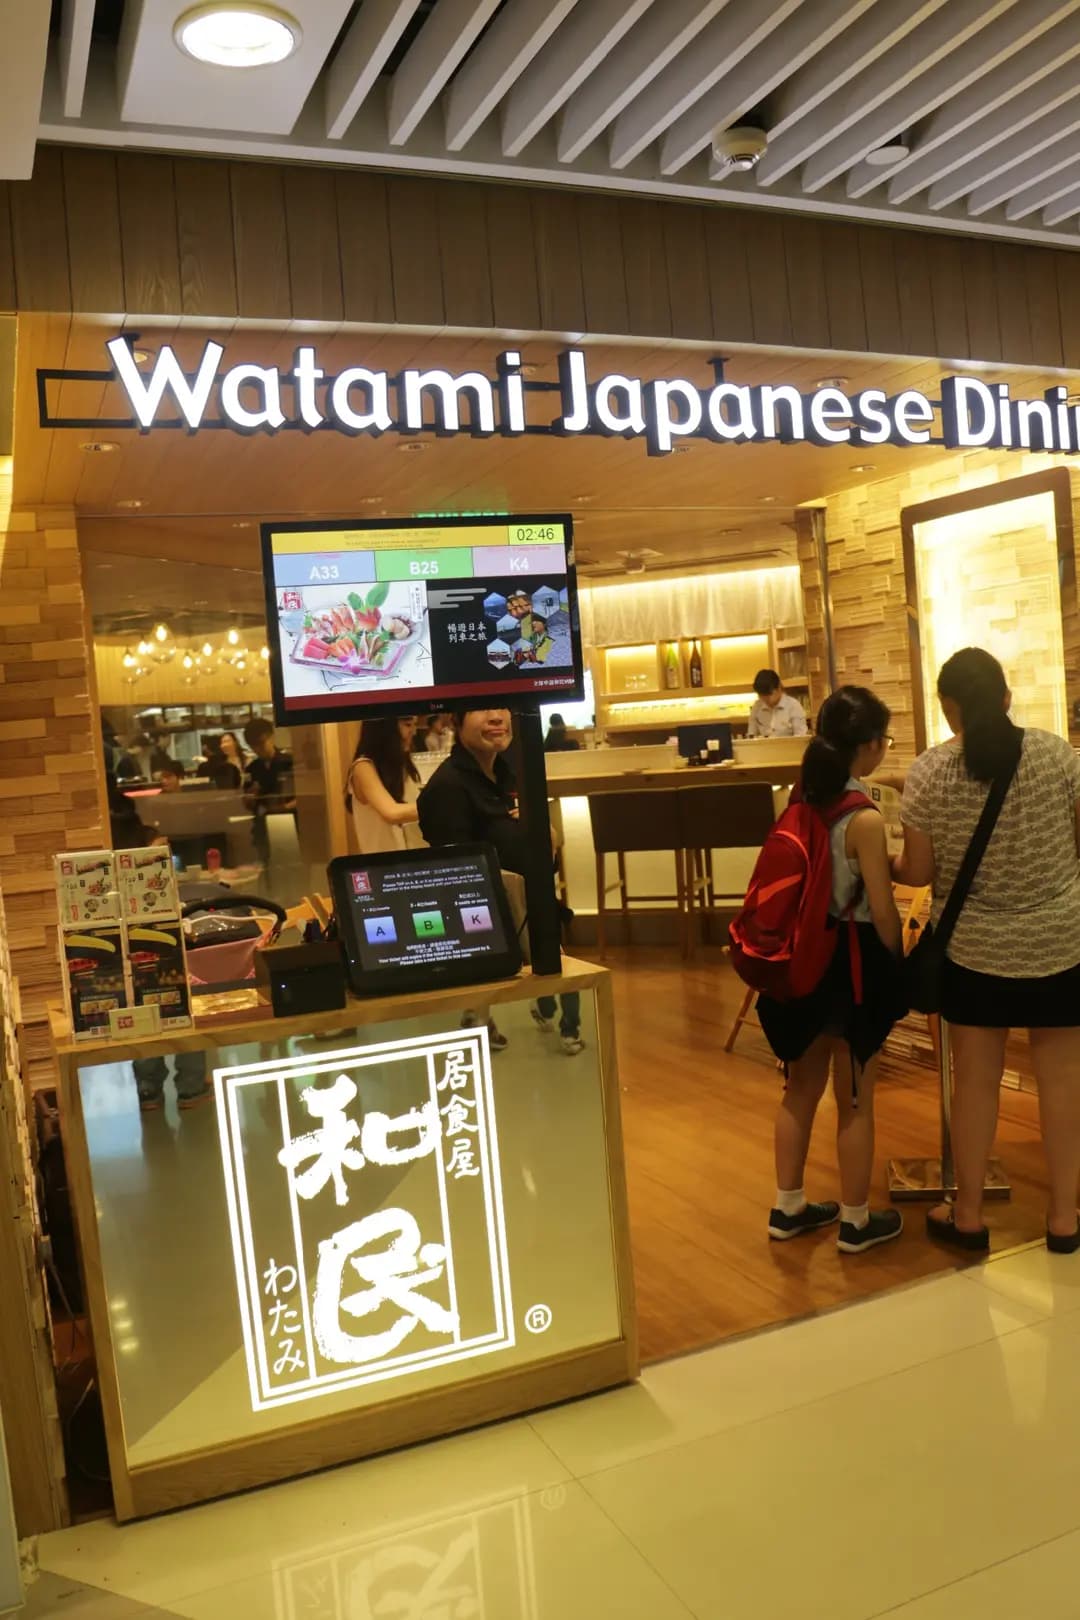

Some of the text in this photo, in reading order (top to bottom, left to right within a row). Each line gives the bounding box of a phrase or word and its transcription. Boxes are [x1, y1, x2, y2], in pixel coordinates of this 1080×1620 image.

[106, 335, 1080, 454] Watami Japanese Dini
[516, 527, 555, 542] 02:46
[409, 561, 440, 576] B25
[509, 558, 529, 571] K4
[309, 565, 340, 580] A33
[424, 920, 434, 930] B
[471, 914, 481, 925] K
[375, 926, 386, 937] A
[436, 1050, 481, 1180] 居食屋
[277, 1073, 461, 1364] 和民
[263, 1257, 306, 1376] わたみ
